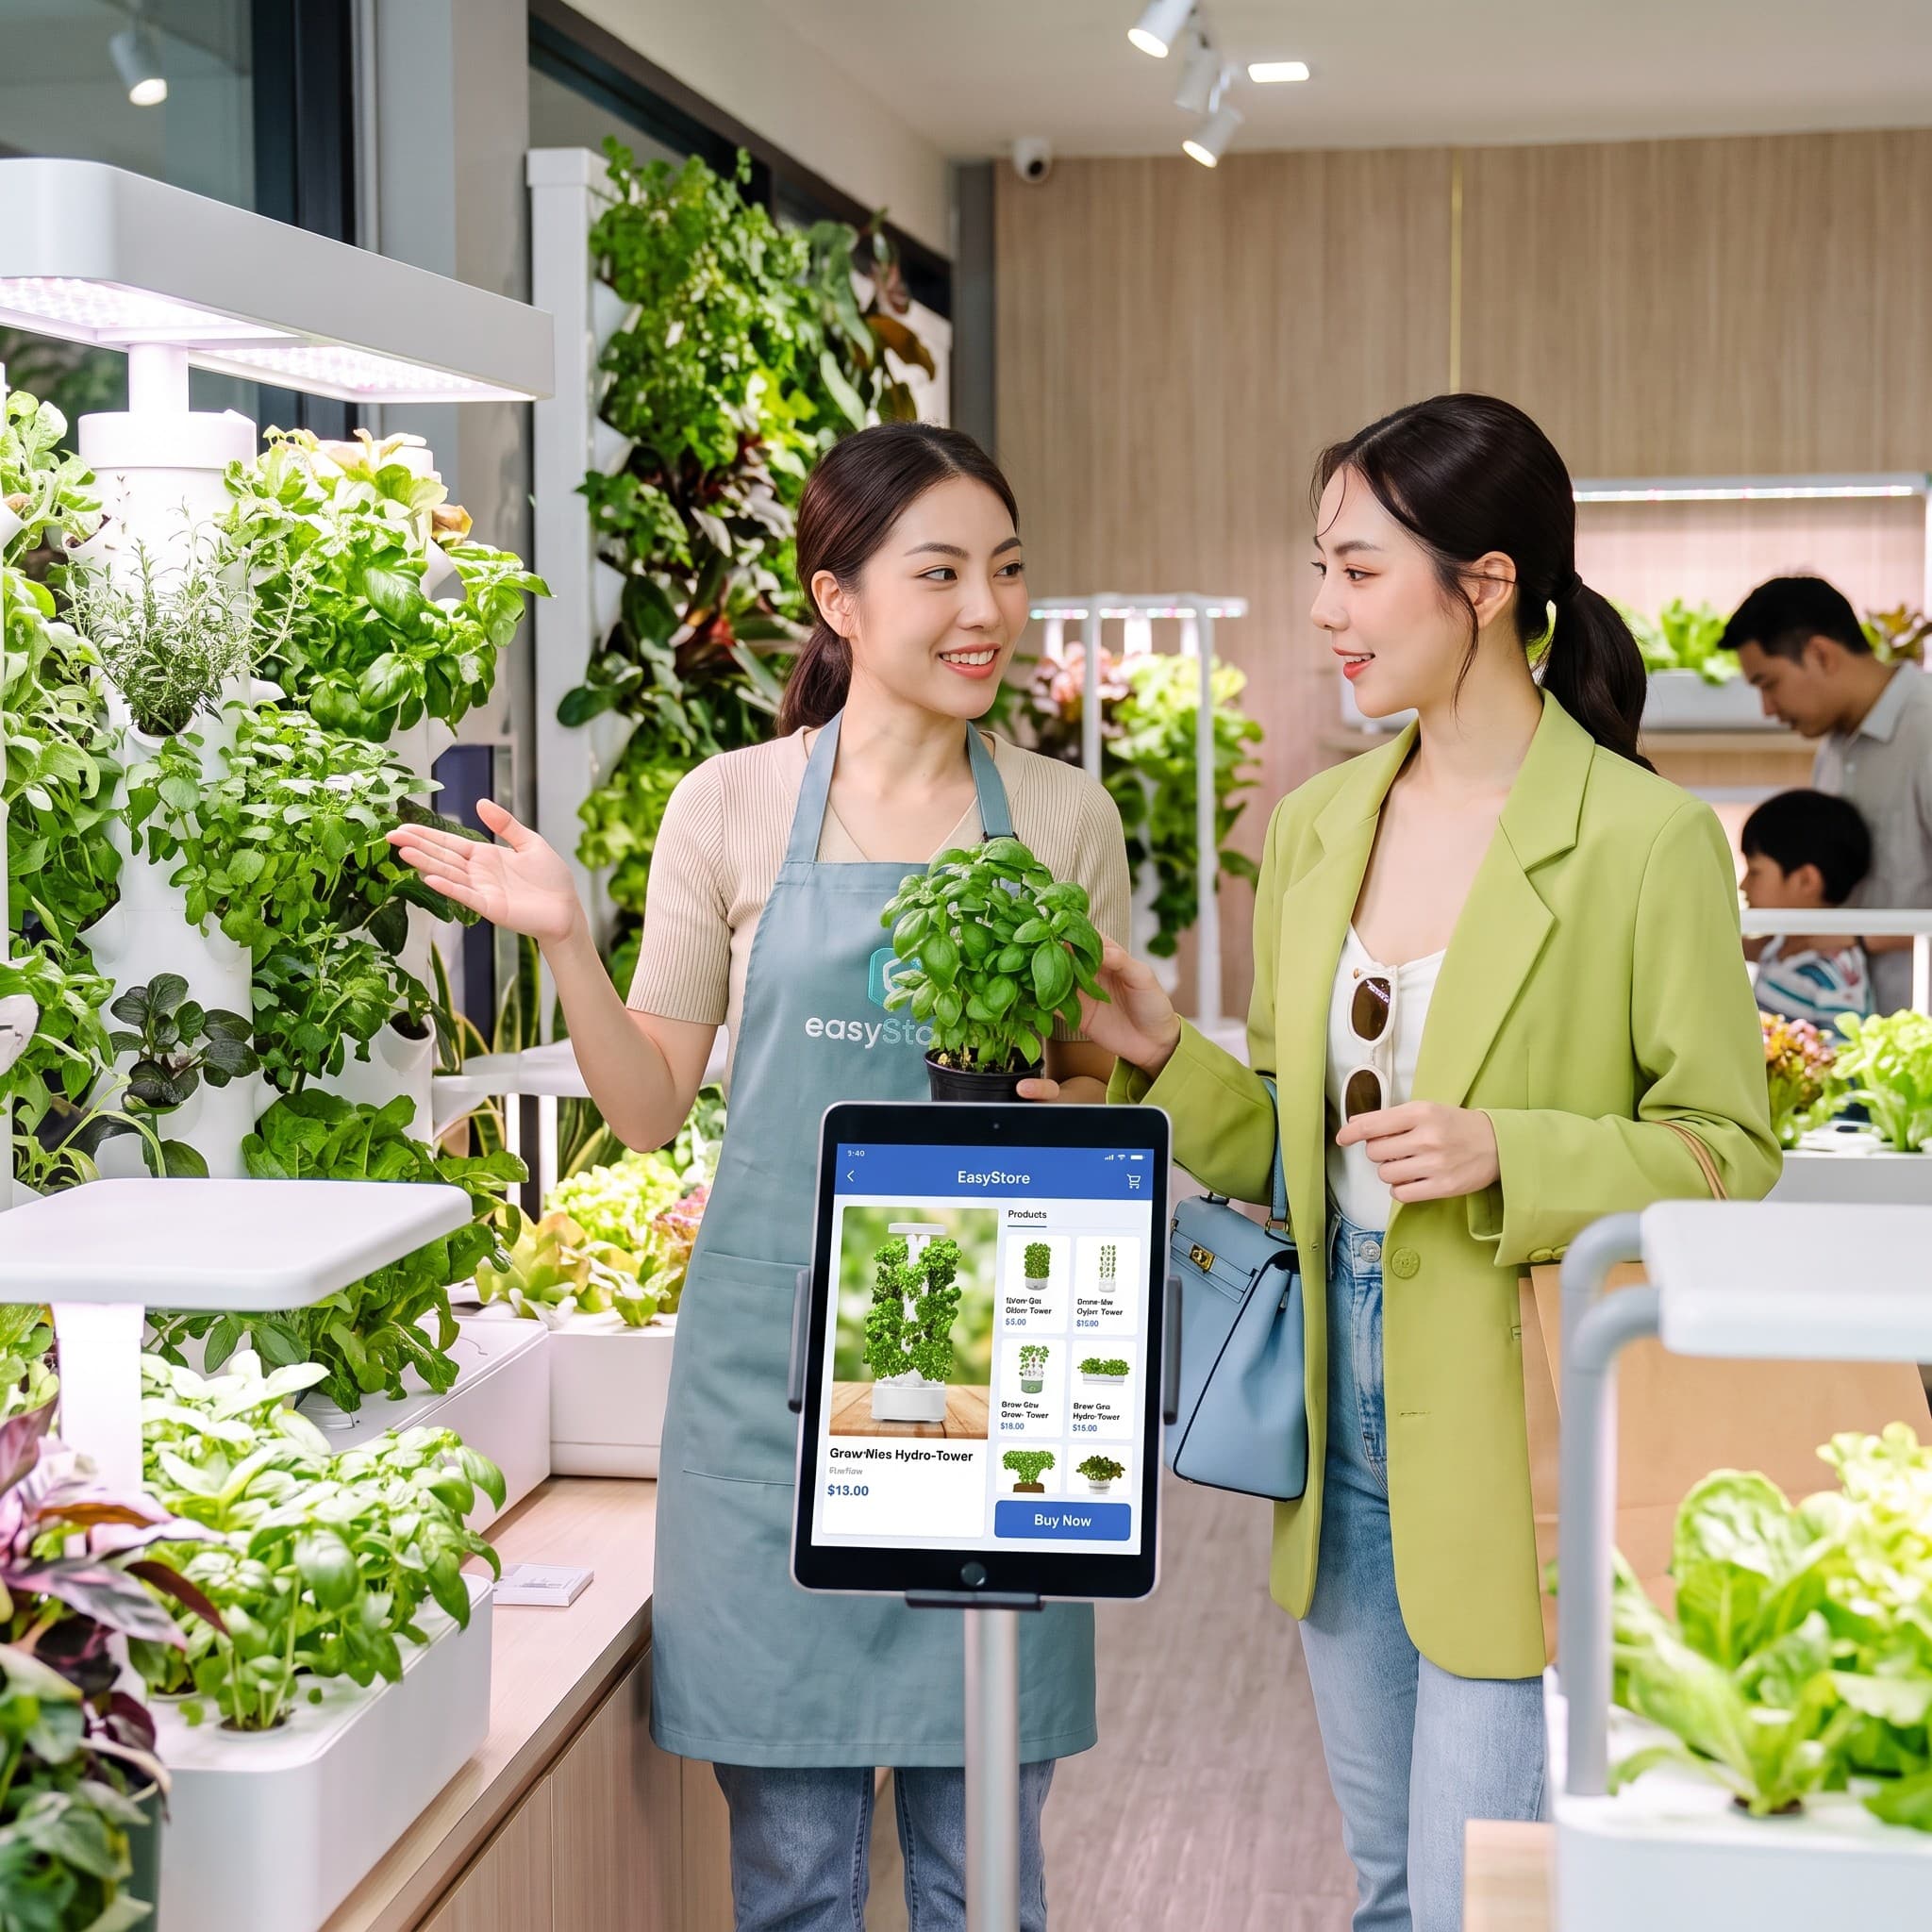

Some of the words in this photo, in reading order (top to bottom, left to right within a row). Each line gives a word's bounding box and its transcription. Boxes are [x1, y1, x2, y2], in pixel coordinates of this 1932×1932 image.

[805, 1017, 934, 1049] easySto
[958, 1170, 1031, 1187] EasyStore
[1008, 1209, 1047, 1219] Products
[1101, 1307, 1124, 1316] Tower
[1000, 1422, 1024, 1430] $18.00
[1073, 1424, 1097, 1432] $15.00
[895, 1449, 974, 1462] Hydro-Tower
[827, 1483, 869, 1497] $13.00
[1034, 1513, 1059, 1529] Buy
[1062, 1515, 1092, 1527] Now
